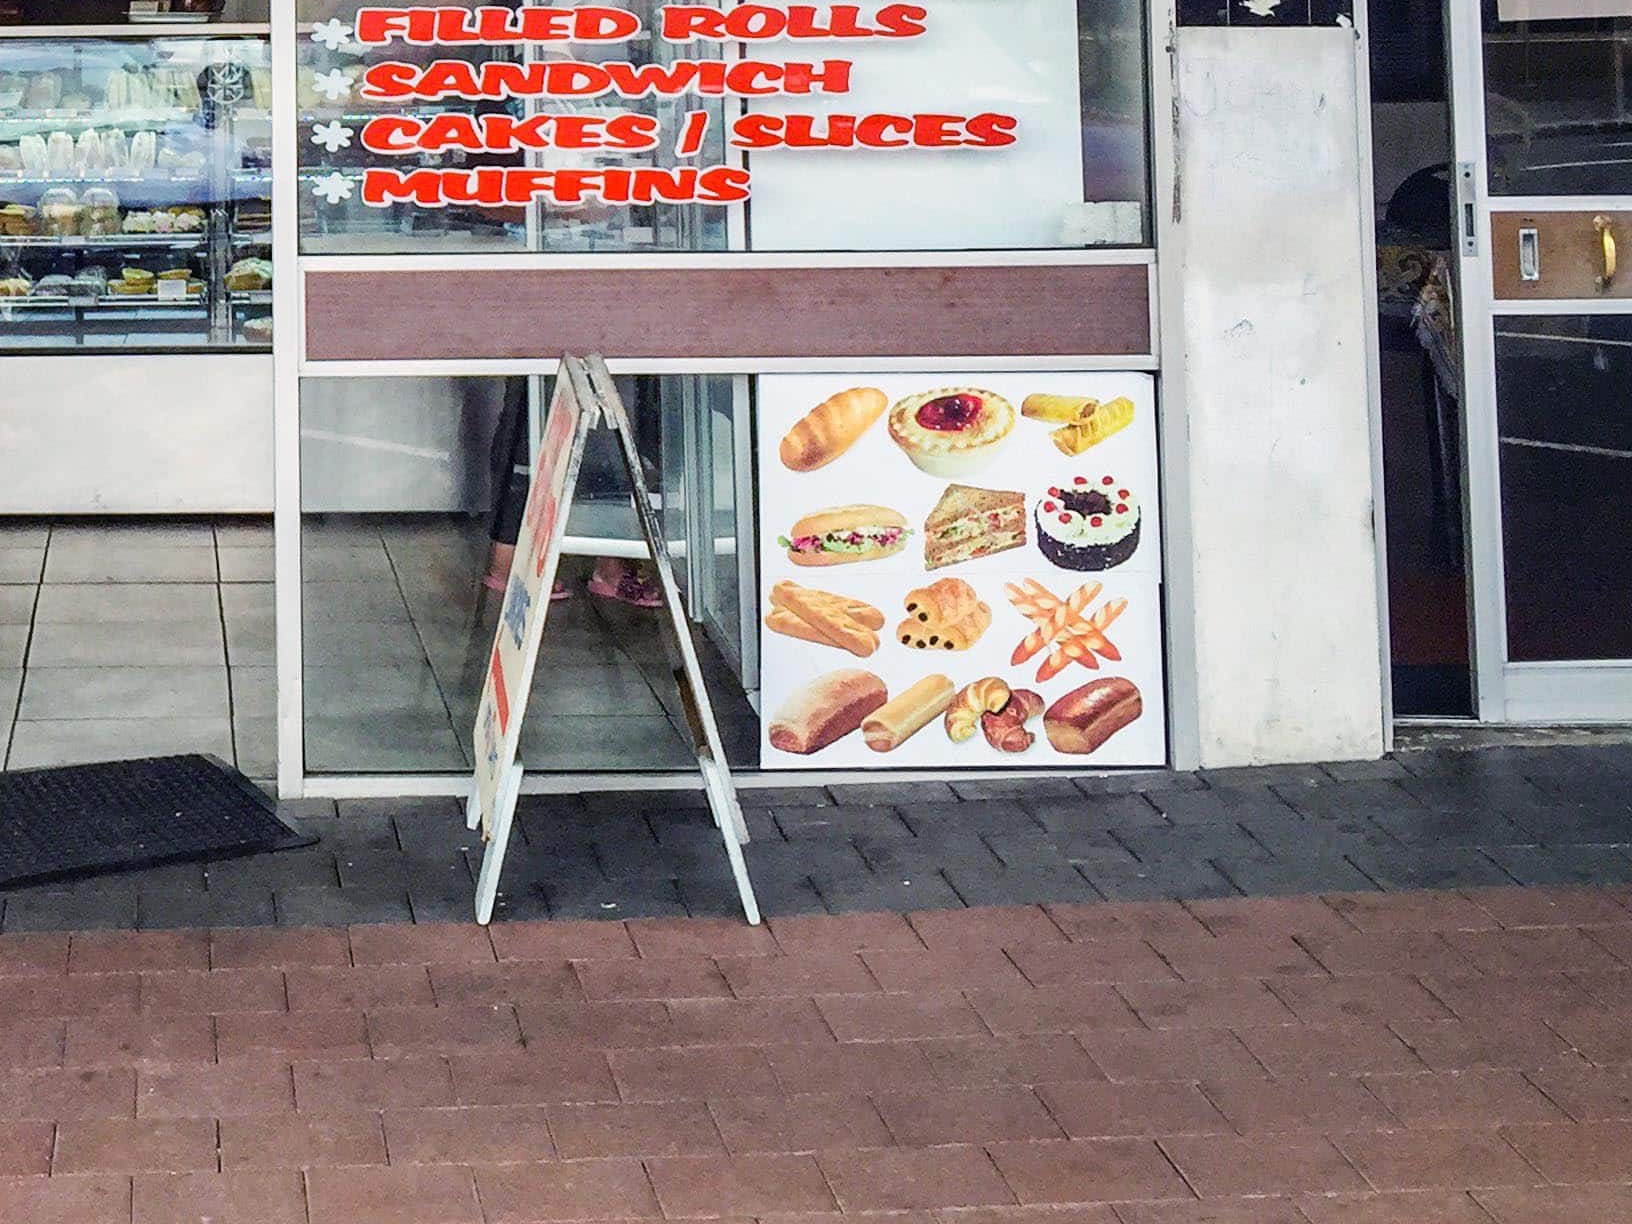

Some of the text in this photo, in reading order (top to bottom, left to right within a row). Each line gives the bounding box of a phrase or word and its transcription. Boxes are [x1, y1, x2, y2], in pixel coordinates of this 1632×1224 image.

[356, 3, 929, 45] FILLED ROLLS
[361, 59, 854, 100] SANDWICH
[360, 113, 660, 154] CAKES
[730, 112, 1019, 151] SLICES
[362, 167, 751, 207] MUFFINS
